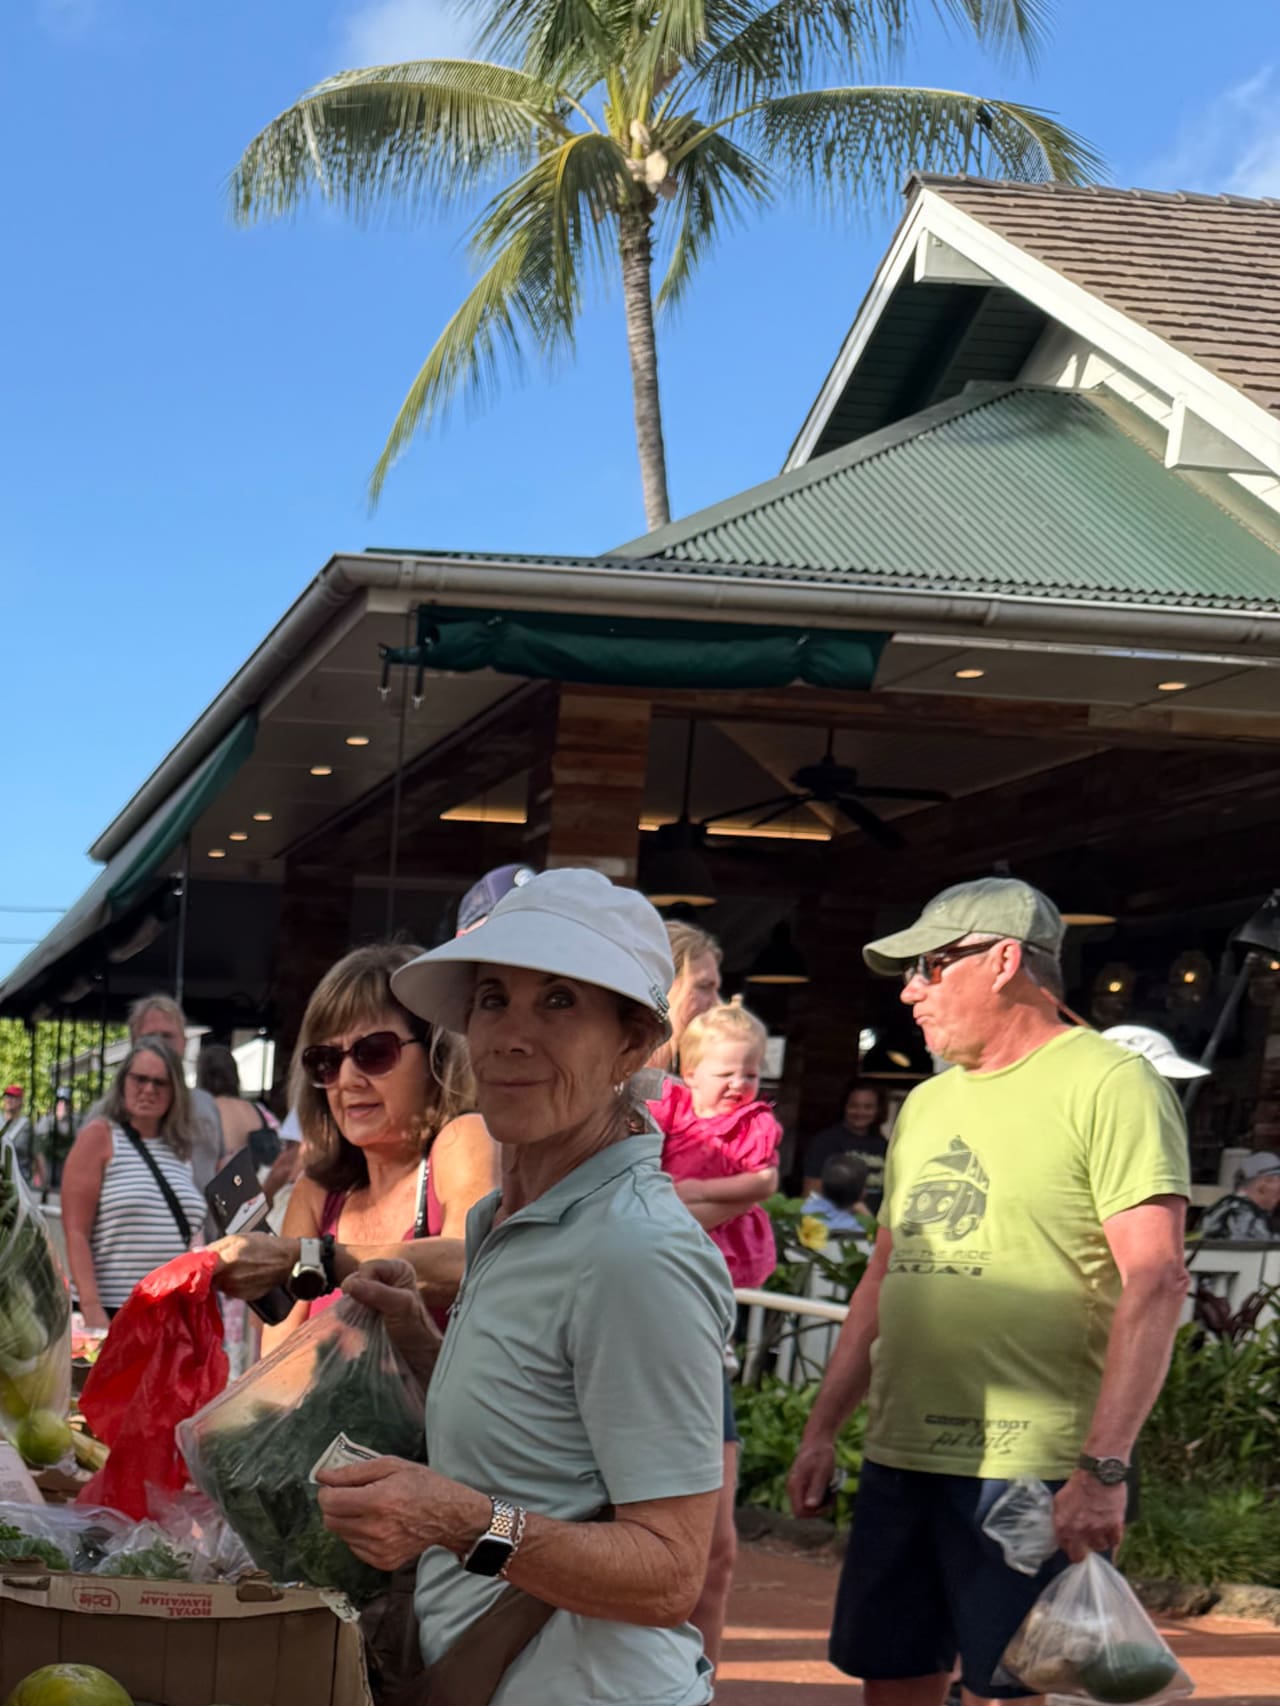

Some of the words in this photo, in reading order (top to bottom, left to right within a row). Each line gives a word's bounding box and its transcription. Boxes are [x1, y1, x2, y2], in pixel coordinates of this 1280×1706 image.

[80, 1593, 112, 1608] Dole
[140, 1595, 212, 1608] HAWAIIAN
[169, 1606, 212, 1617] ROYAL
